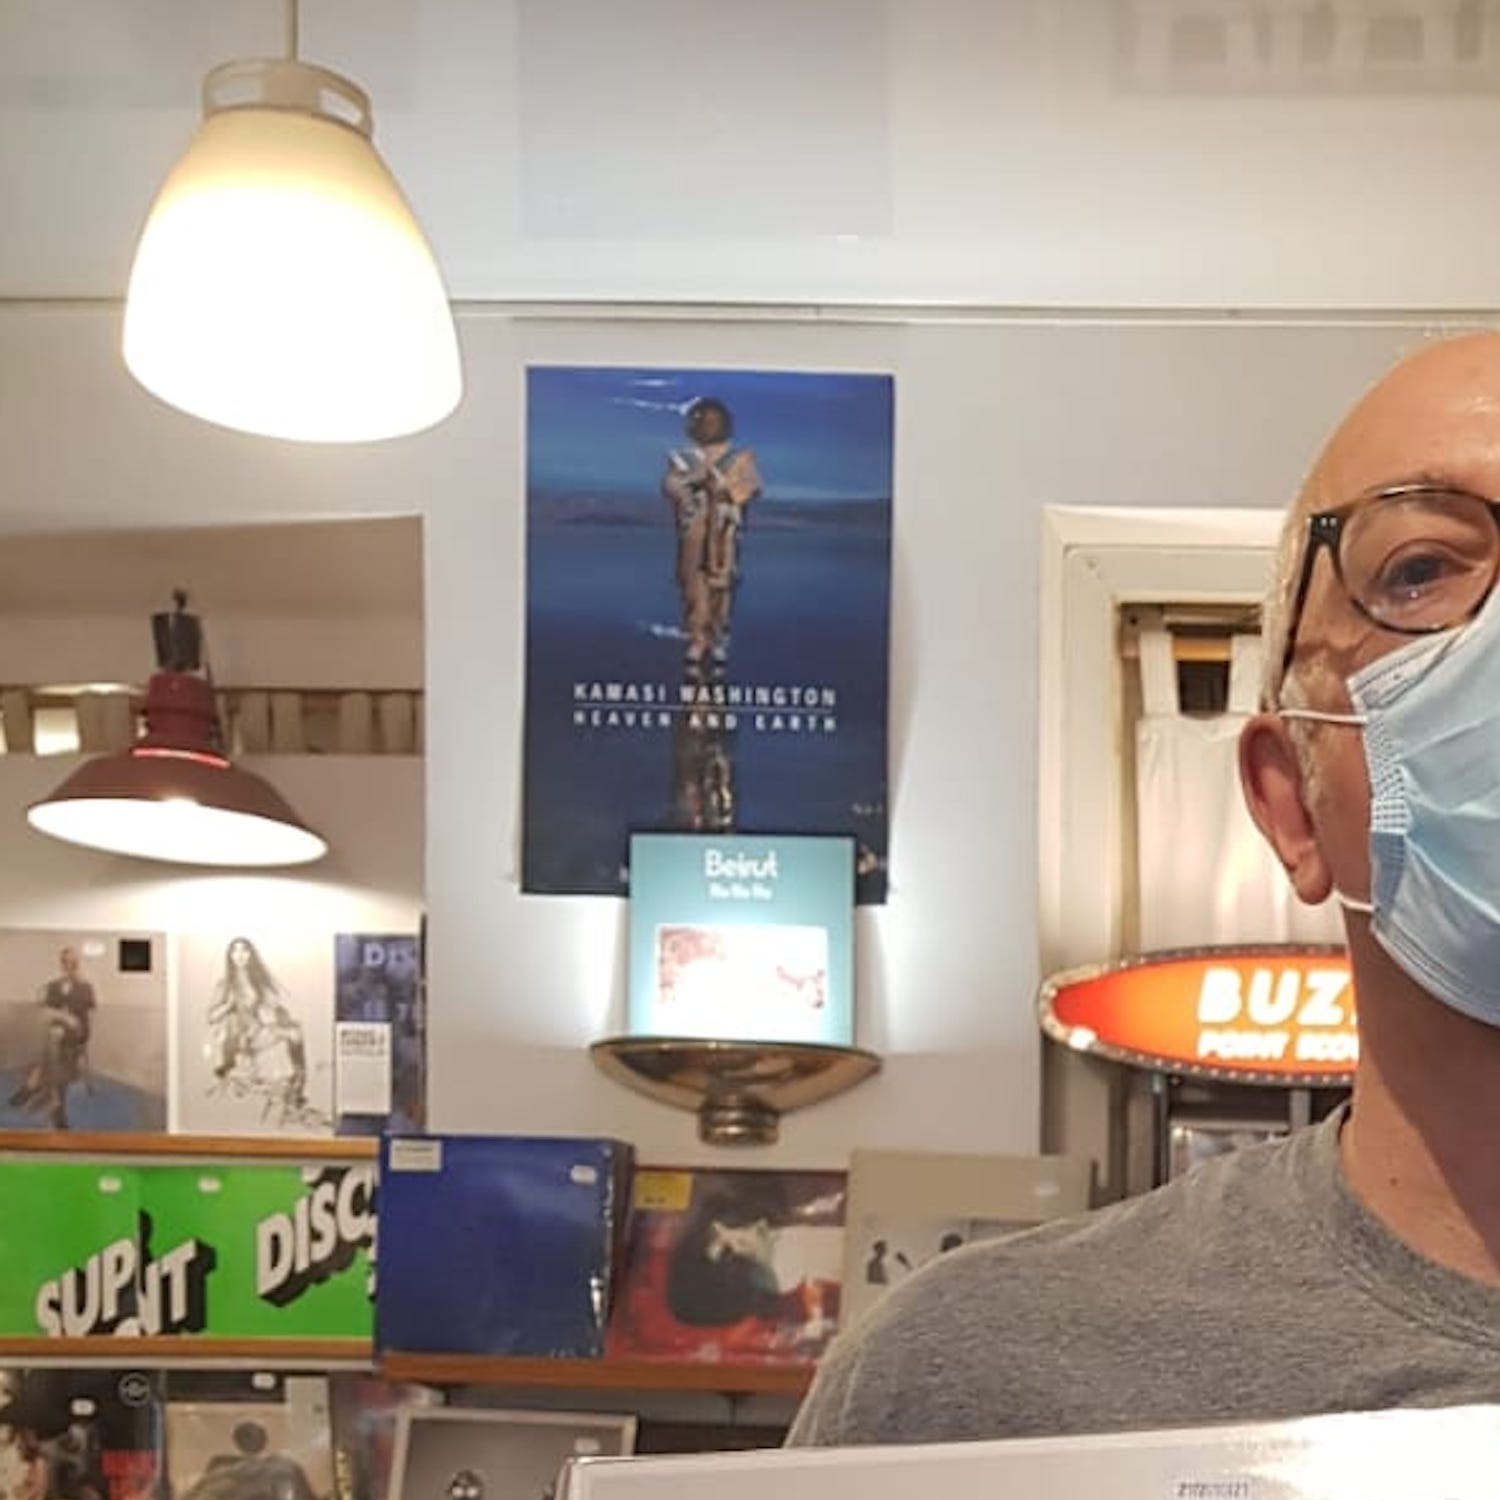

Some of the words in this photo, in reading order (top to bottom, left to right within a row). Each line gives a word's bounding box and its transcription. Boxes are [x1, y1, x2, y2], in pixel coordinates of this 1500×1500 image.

[574, 683, 666, 701] KAMASI
[680, 685, 836, 706] WASHINGTON
[573, 711, 672, 727] HEAVEN
[688, 713, 737, 730] AND
[755, 715, 836, 732] EARTH
[705, 849, 778, 878] Beirut
[1198, 967, 1357, 1026] BUZ
